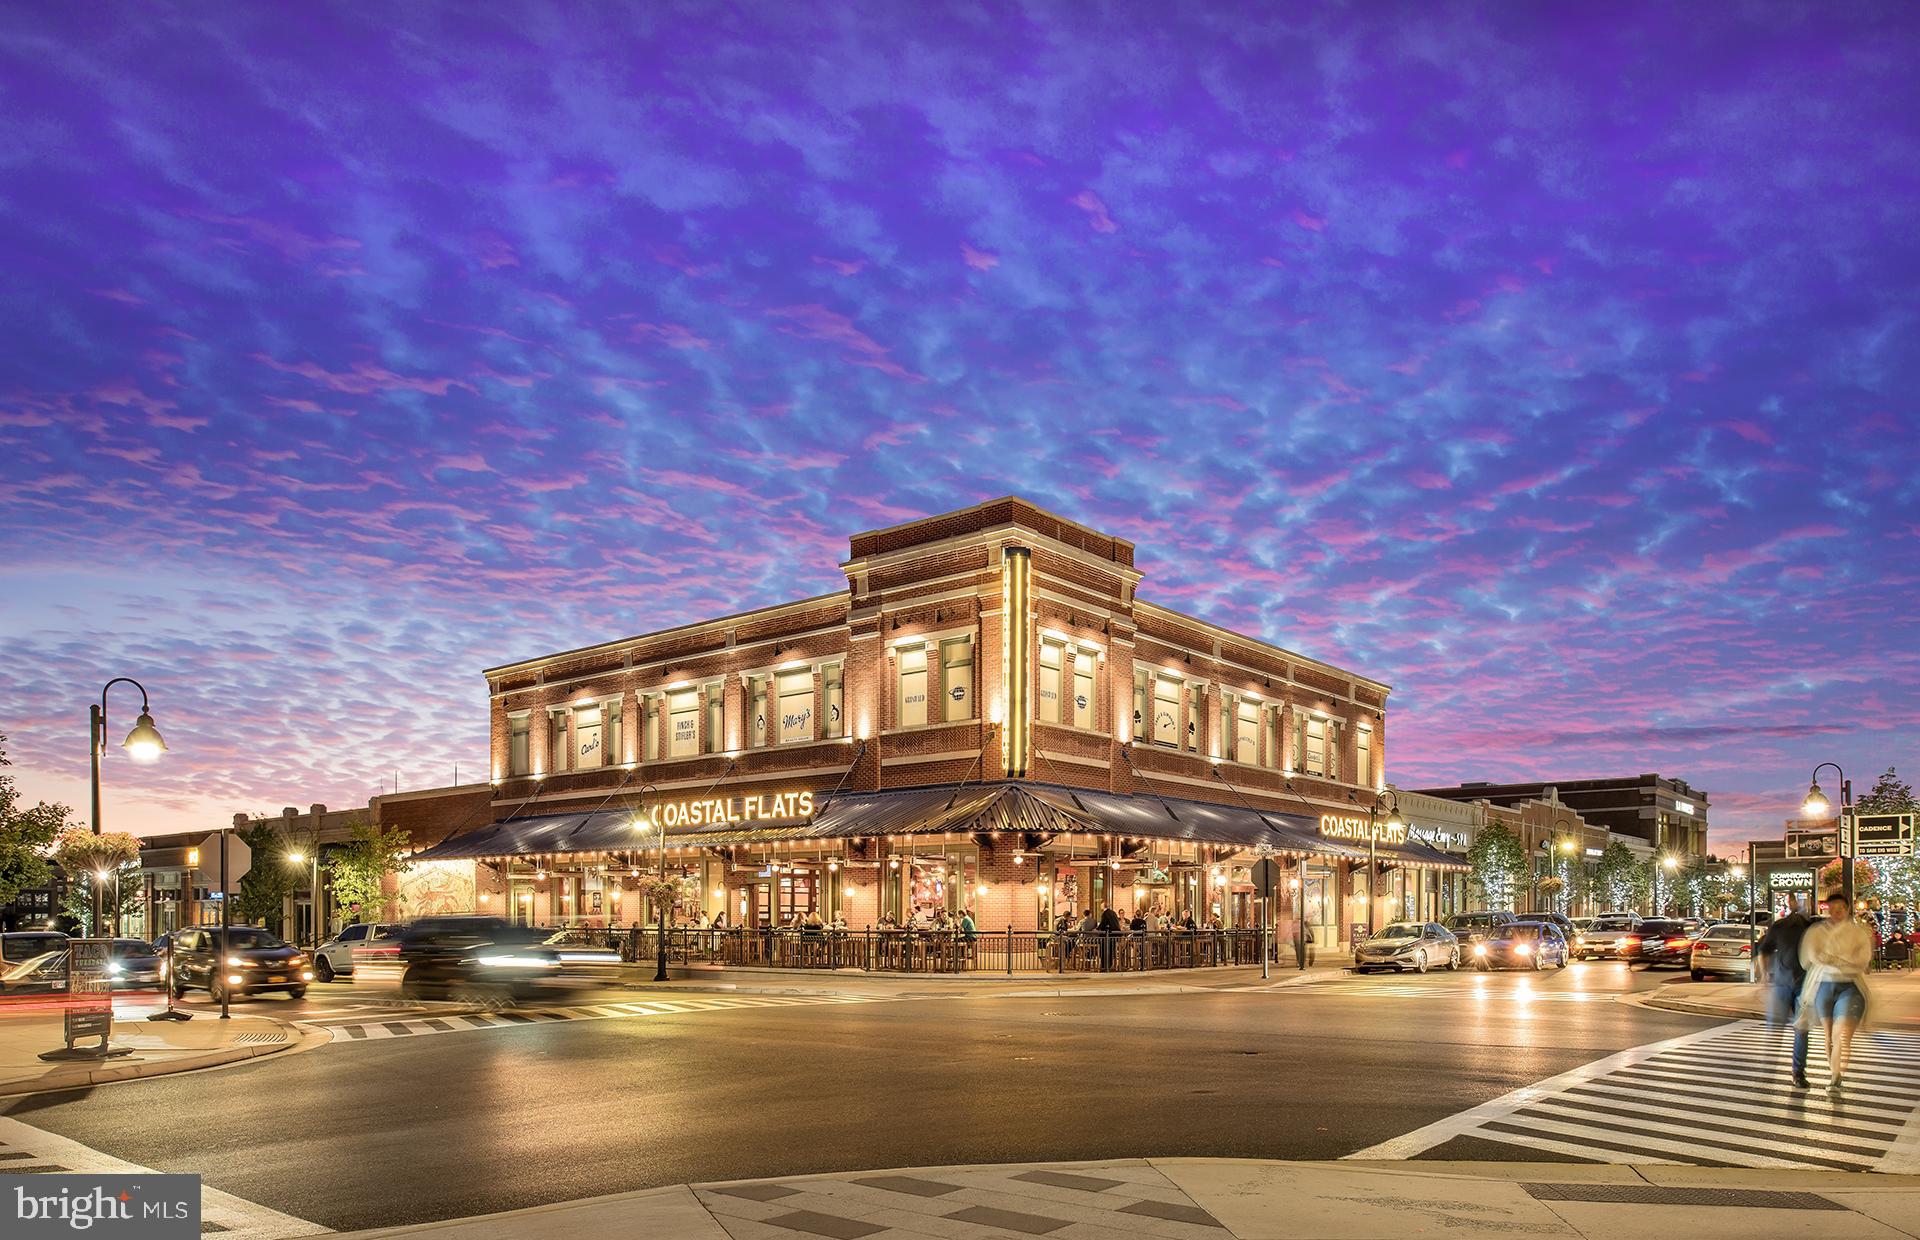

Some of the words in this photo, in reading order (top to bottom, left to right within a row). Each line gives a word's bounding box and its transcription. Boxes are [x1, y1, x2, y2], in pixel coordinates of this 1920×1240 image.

[783, 708, 810, 730] Mary's
[651, 798, 739, 826] COASTAL
[744, 791, 814, 819] FLATS
[1321, 815, 1371, 841] COASTAL
[1372, 821, 1405, 844] FLATS
[1770, 872, 1813, 880] DOWNTOWN
[1770, 879, 1813, 887] CROWN
[74, 944, 108, 959] TACO
